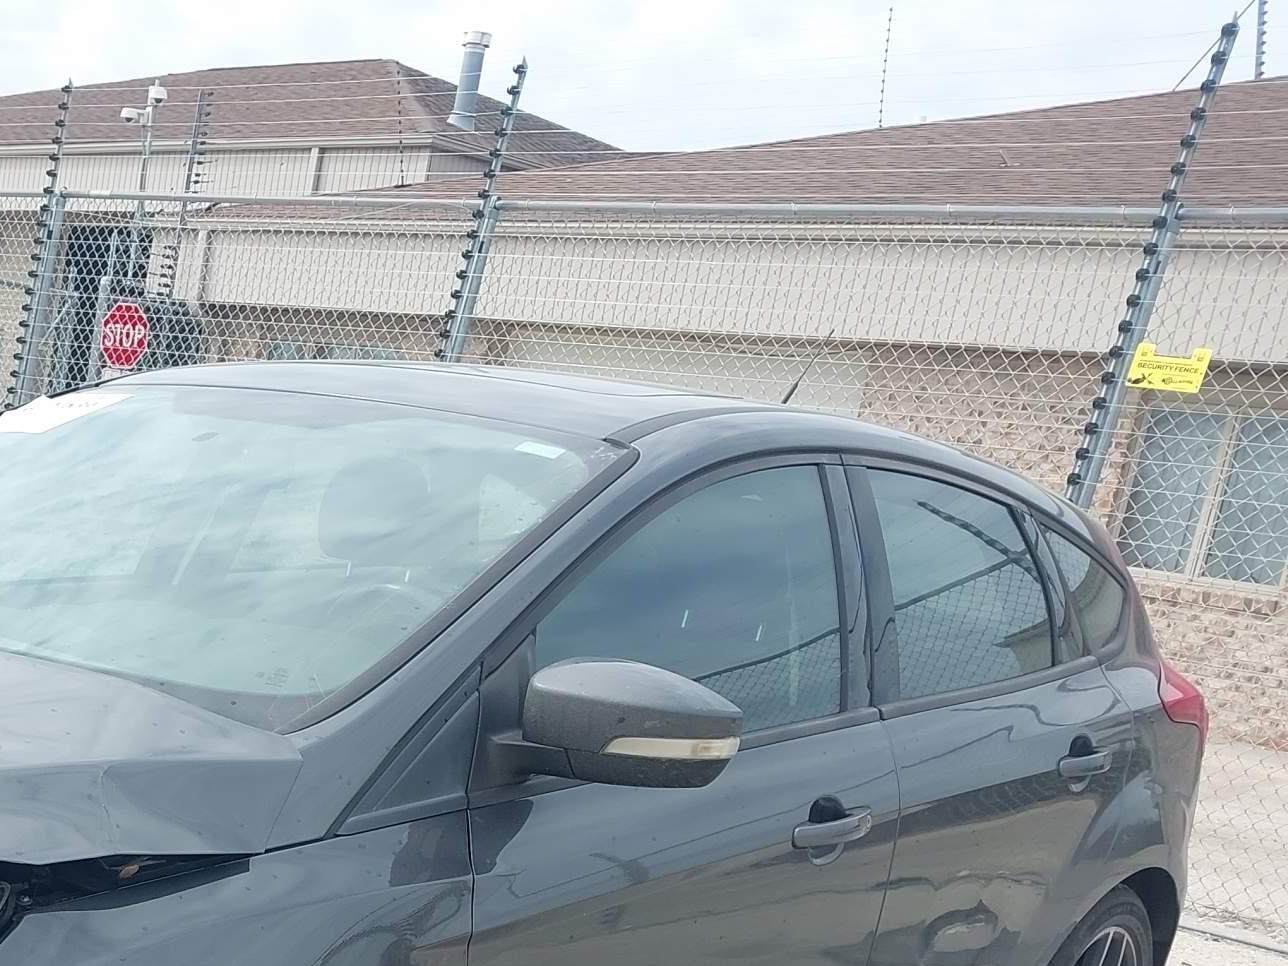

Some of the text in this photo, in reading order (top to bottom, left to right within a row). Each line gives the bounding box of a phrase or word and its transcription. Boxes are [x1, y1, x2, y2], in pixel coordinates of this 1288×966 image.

[104, 323, 145, 348] STOP
[1137, 361, 1174, 372] SECURITY
[1174, 365, 1200, 374] FENCE
